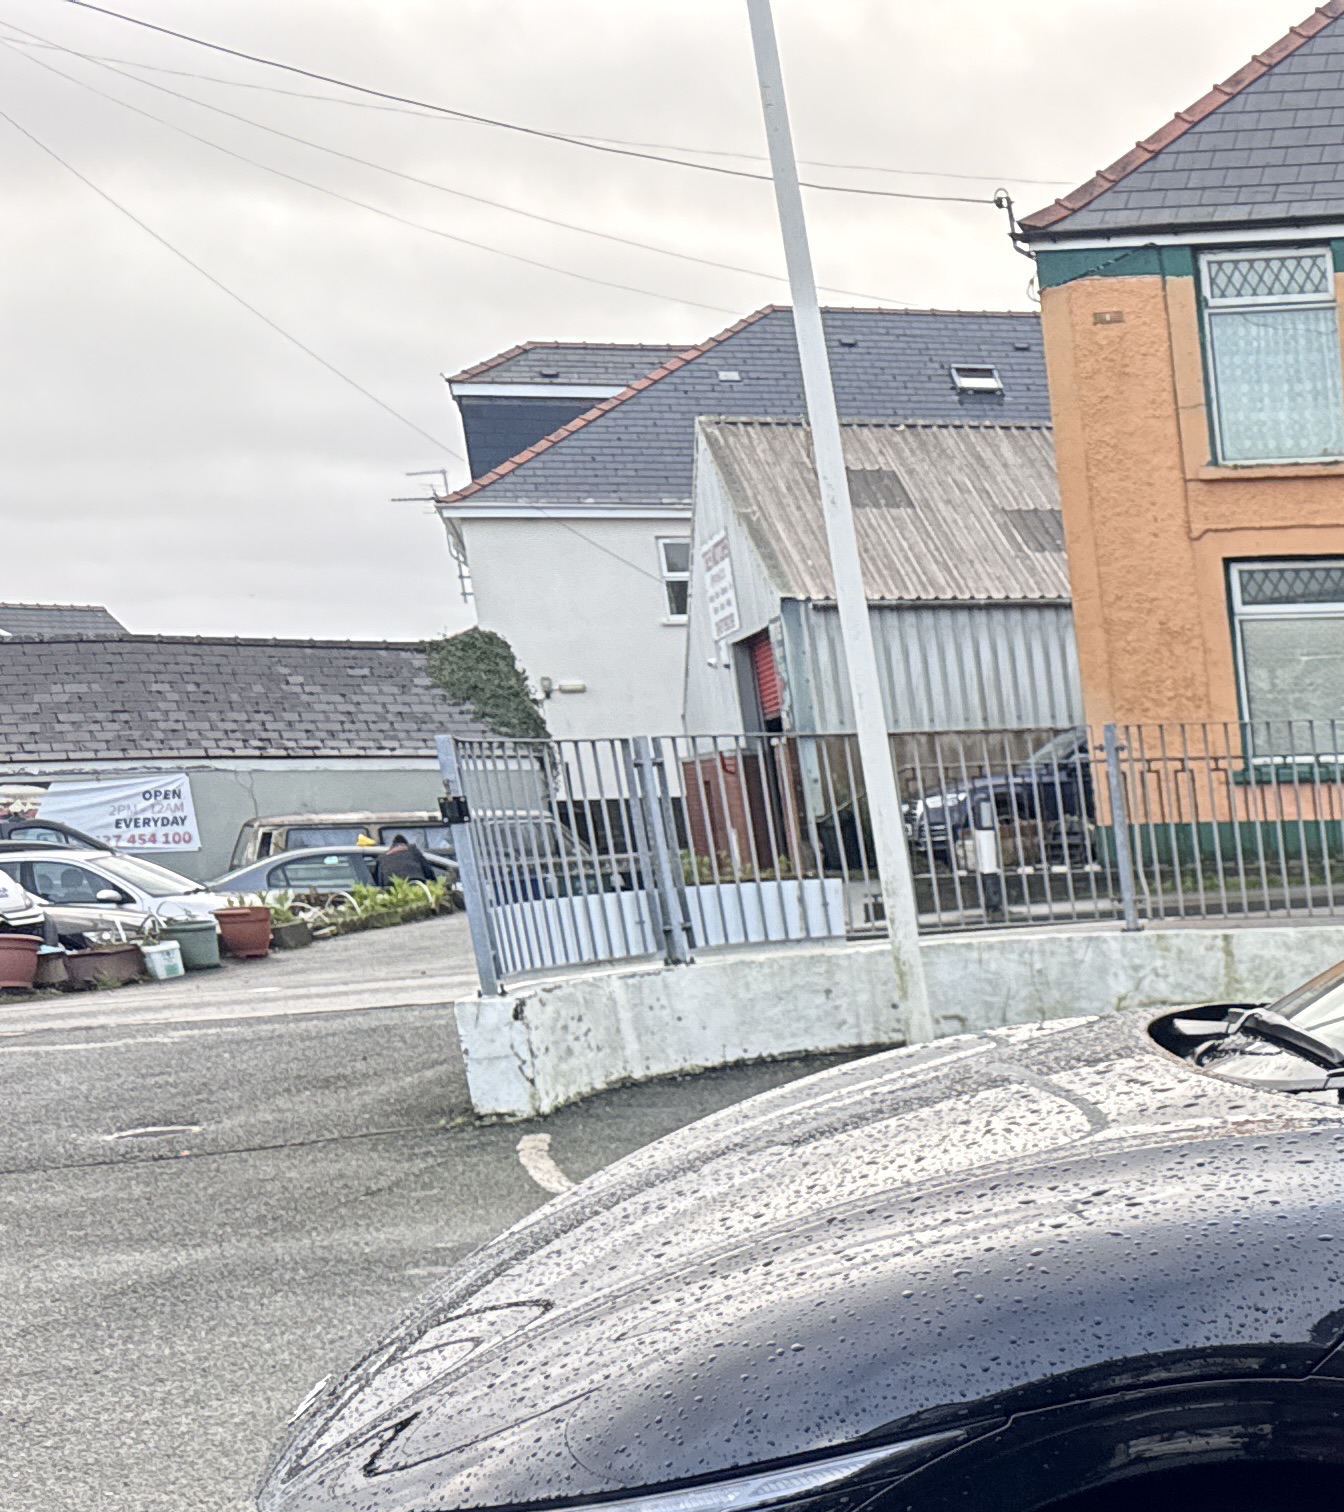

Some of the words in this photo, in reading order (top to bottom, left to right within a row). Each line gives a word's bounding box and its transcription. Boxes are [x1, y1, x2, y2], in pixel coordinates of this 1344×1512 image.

[142, 788, 182, 801] OPEN
[114, 815, 187, 829] EVERYDAY
[127, 833, 157, 845] 454
[162, 831, 193, 845] 100
